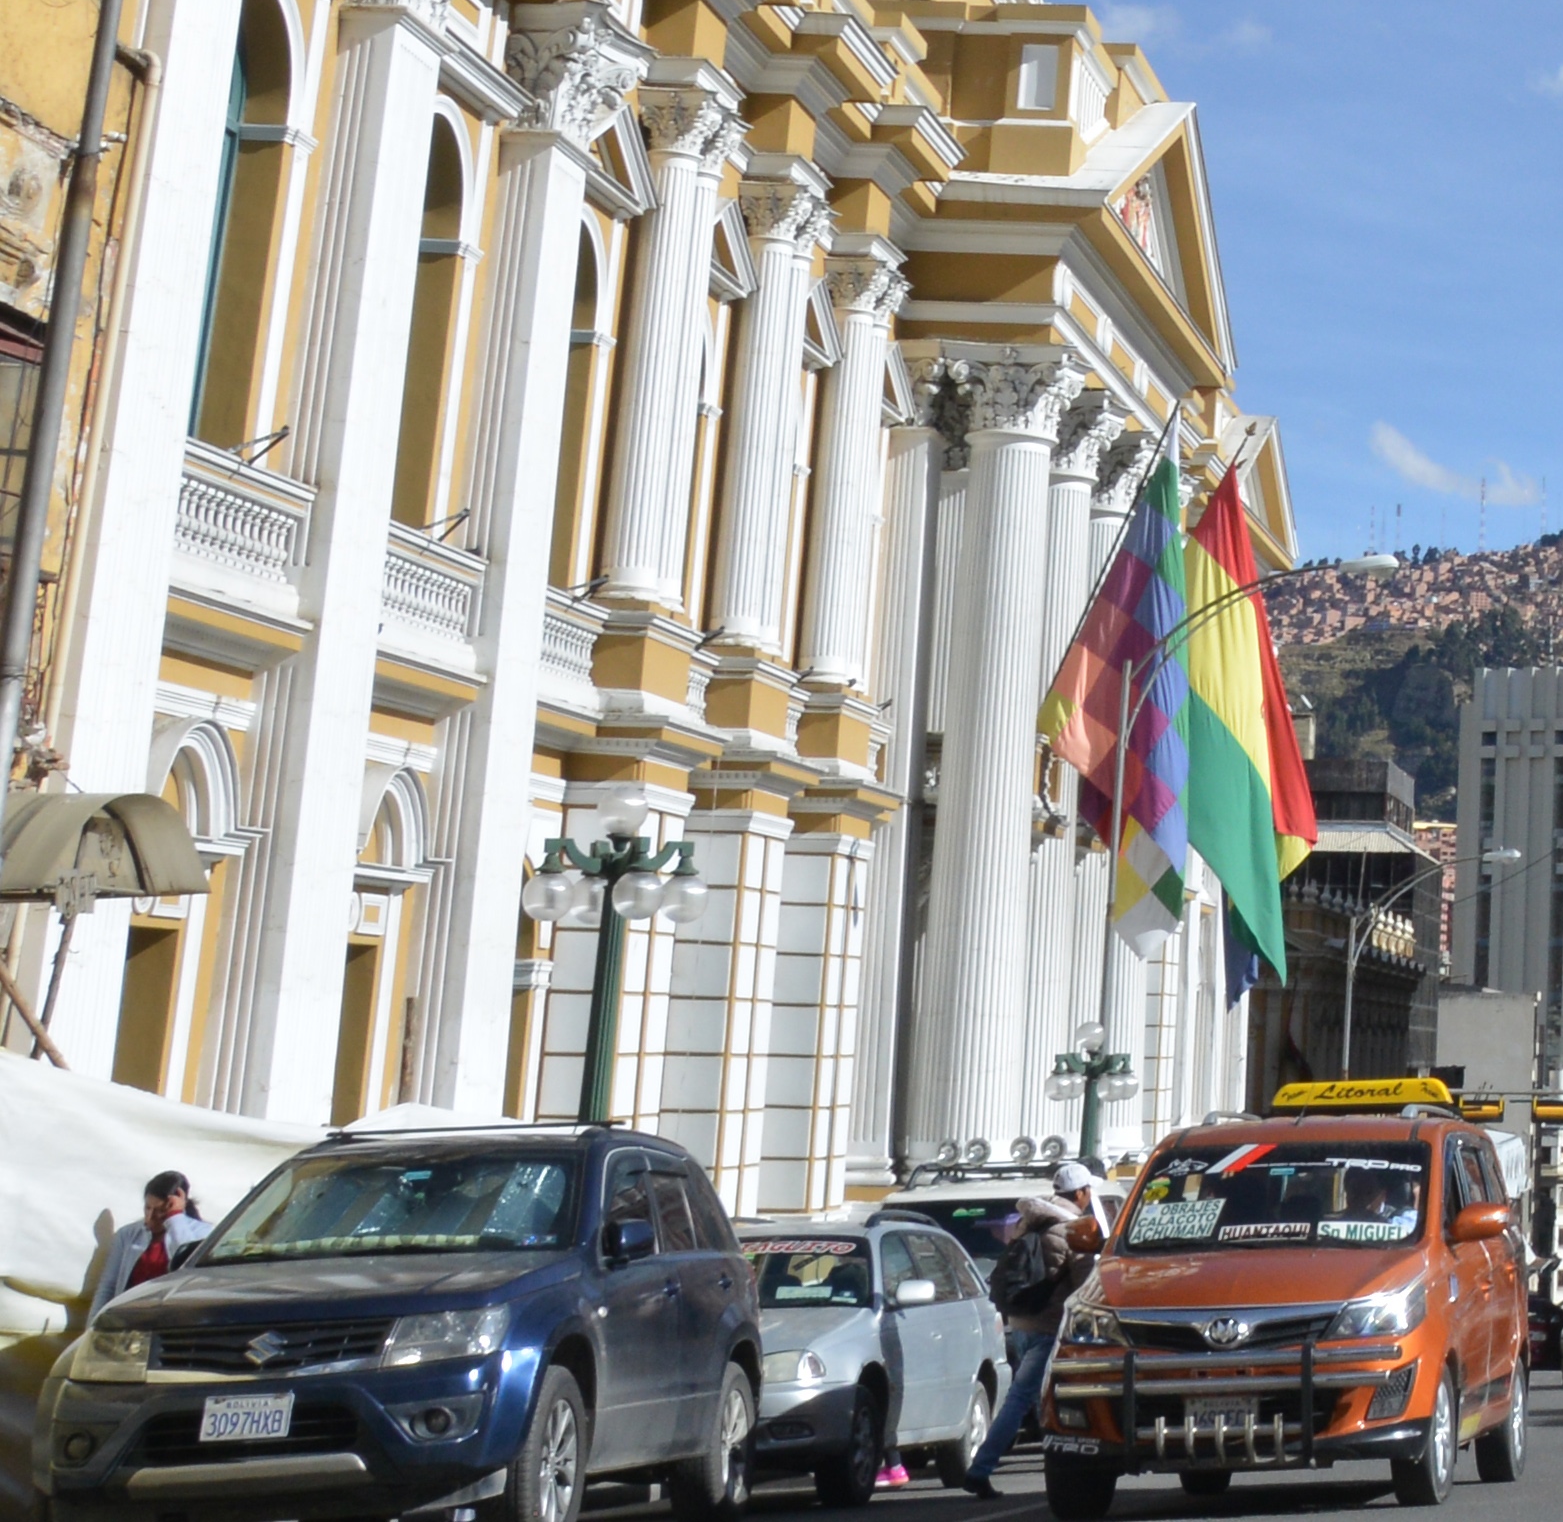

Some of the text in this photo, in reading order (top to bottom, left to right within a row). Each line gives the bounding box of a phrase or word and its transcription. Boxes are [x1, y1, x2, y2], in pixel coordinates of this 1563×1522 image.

[1313, 1082, 1403, 1100] Litoral
[1325, 1158, 1389, 1170] TRD
[1389, 1163, 1422, 1172] PRO
[1160, 1200, 1221, 1216] OBRAJES
[1137, 1212, 1217, 1228] CALACOTO
[1133, 1222, 1214, 1241] ACHUMANI
[226, 1400, 270, 1409] BOLIVIA
[206, 1409, 284, 1437] 3097HXB
